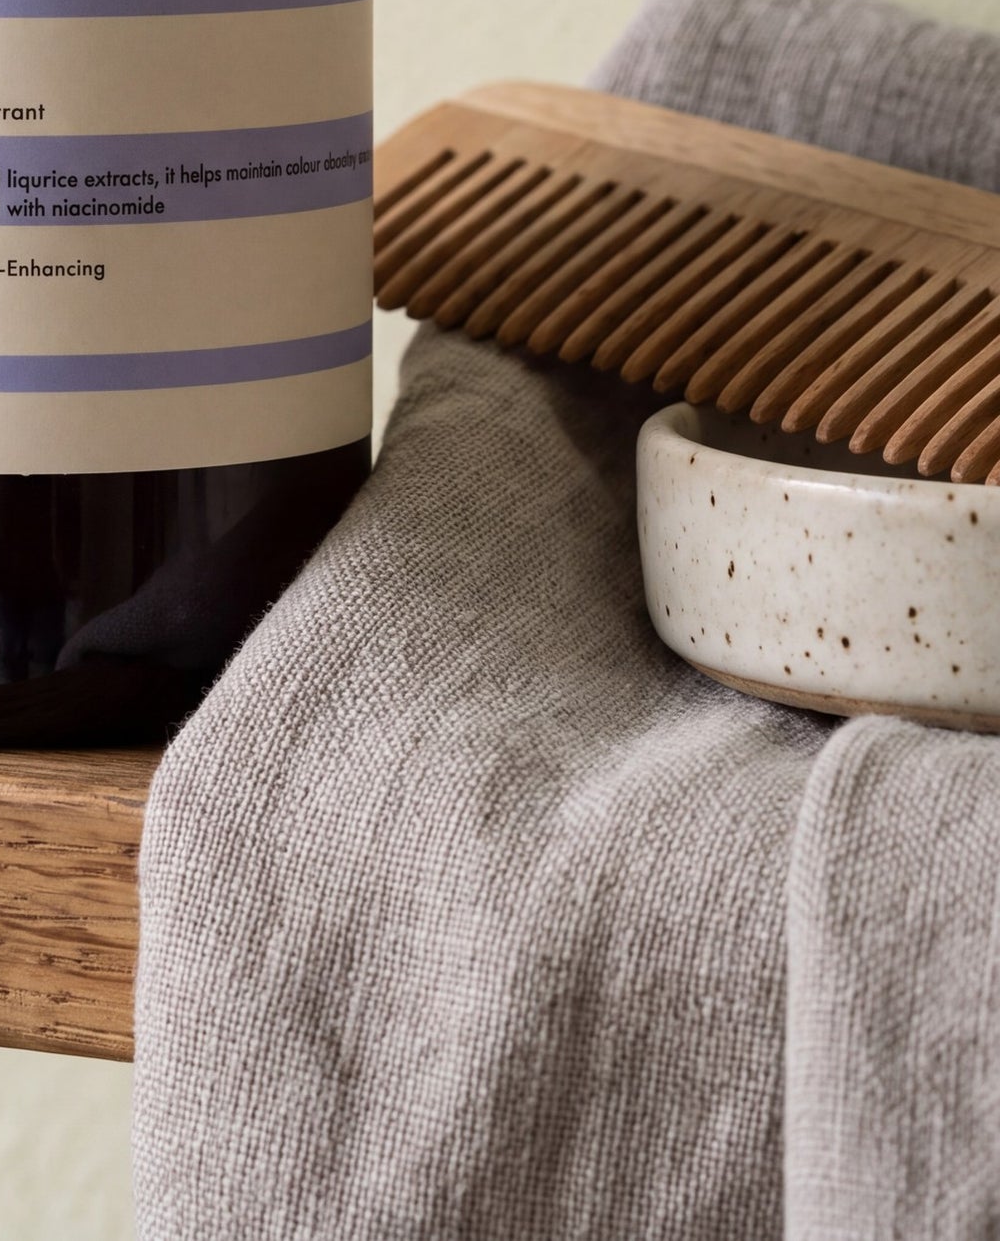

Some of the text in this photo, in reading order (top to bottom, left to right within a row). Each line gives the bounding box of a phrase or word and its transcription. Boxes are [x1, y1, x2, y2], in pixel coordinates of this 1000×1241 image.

[8, 169, 78, 193] liqurice
[84, 170, 159, 189] extracts,
[166, 167, 175, 184] it
[181, 163, 221, 188] helps
[227, 160, 282, 181] maintain
[286, 156, 321, 175] colour
[7, 198, 45, 217] with
